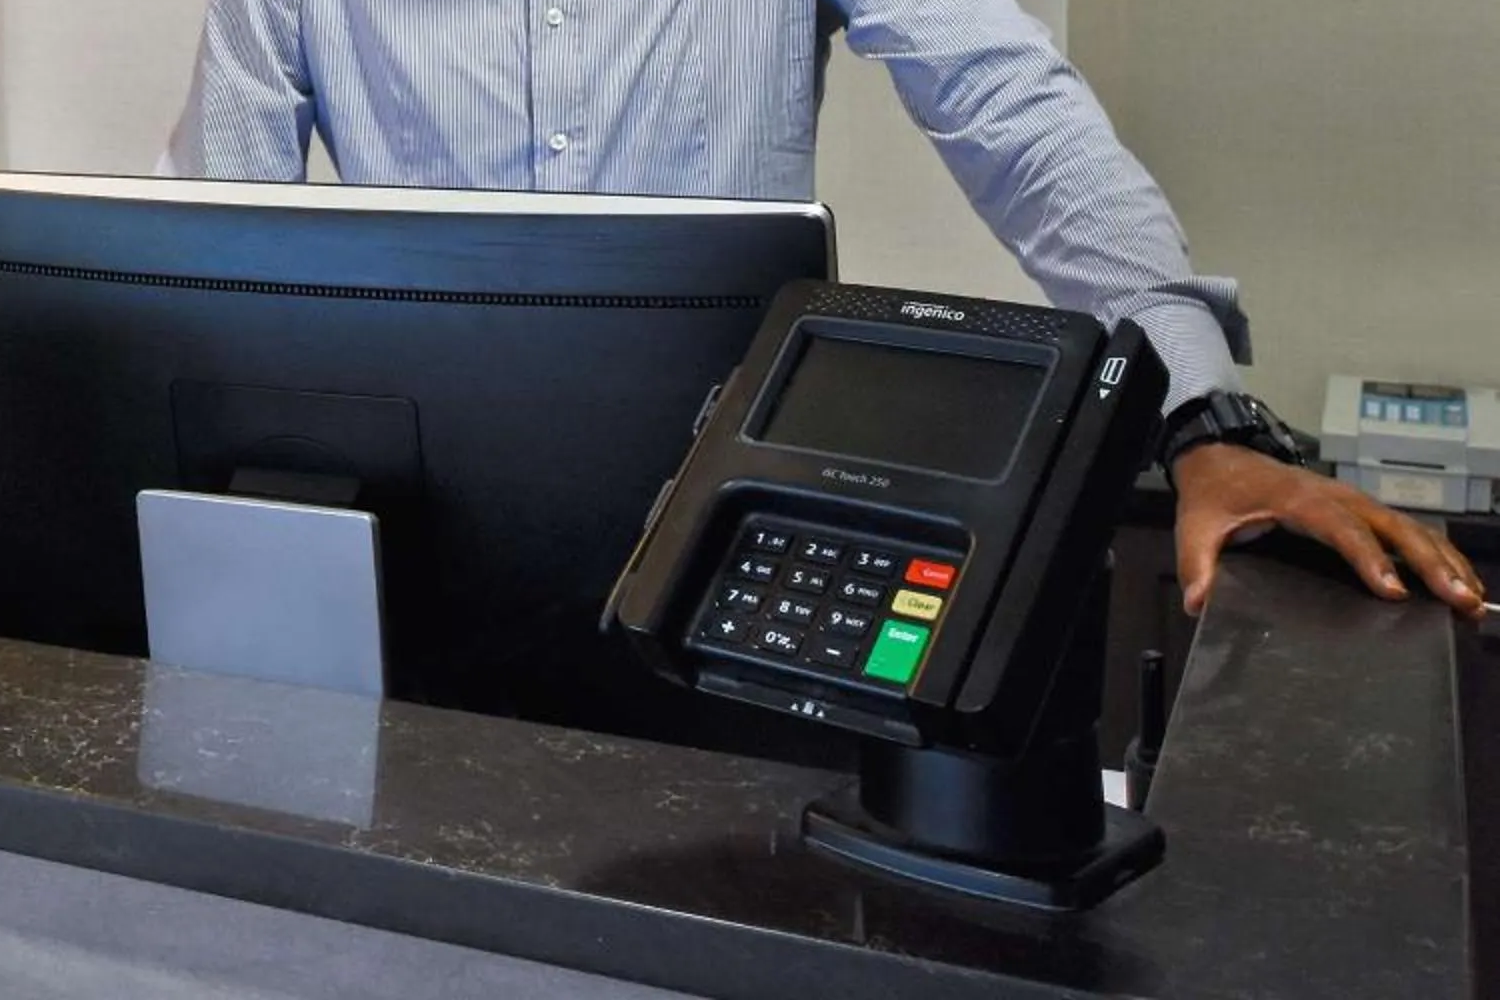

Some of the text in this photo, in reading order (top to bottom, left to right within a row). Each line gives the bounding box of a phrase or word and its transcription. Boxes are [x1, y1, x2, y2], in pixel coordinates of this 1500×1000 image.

[901, 301, 965, 321] ingenico
[805, 543, 817, 555] 2
[857, 553, 870, 565] 3
[740, 561, 751, 573] 4
[792, 571, 803, 583] 5
[728, 589, 739, 600] 7
[843, 583, 855, 595] 6
[779, 600, 791, 613] 8
[831, 611, 843, 625] 9
